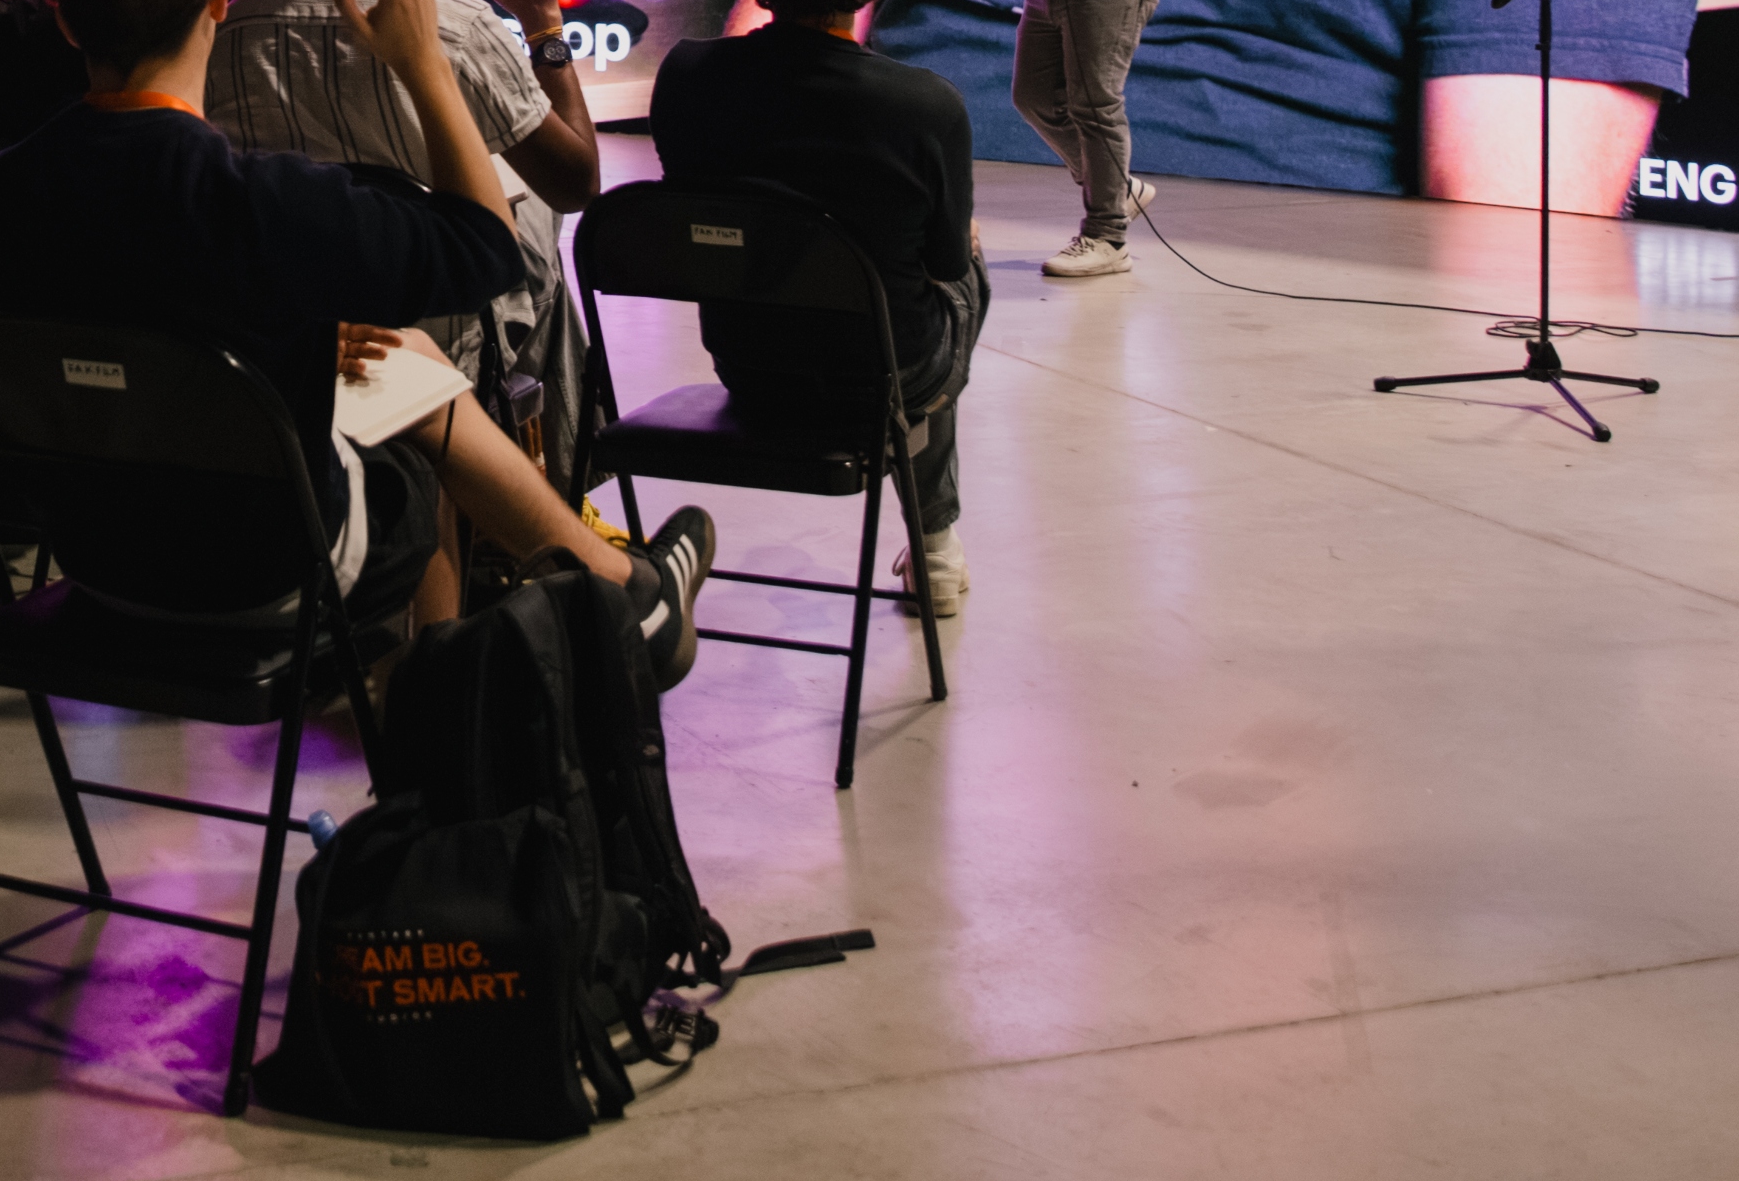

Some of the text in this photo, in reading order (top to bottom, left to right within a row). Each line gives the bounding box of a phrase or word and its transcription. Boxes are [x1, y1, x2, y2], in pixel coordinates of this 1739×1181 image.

[1639, 157, 1737, 206] ENG
[422, 939, 490, 971] BIG.
[392, 971, 527, 1006] SMART.
